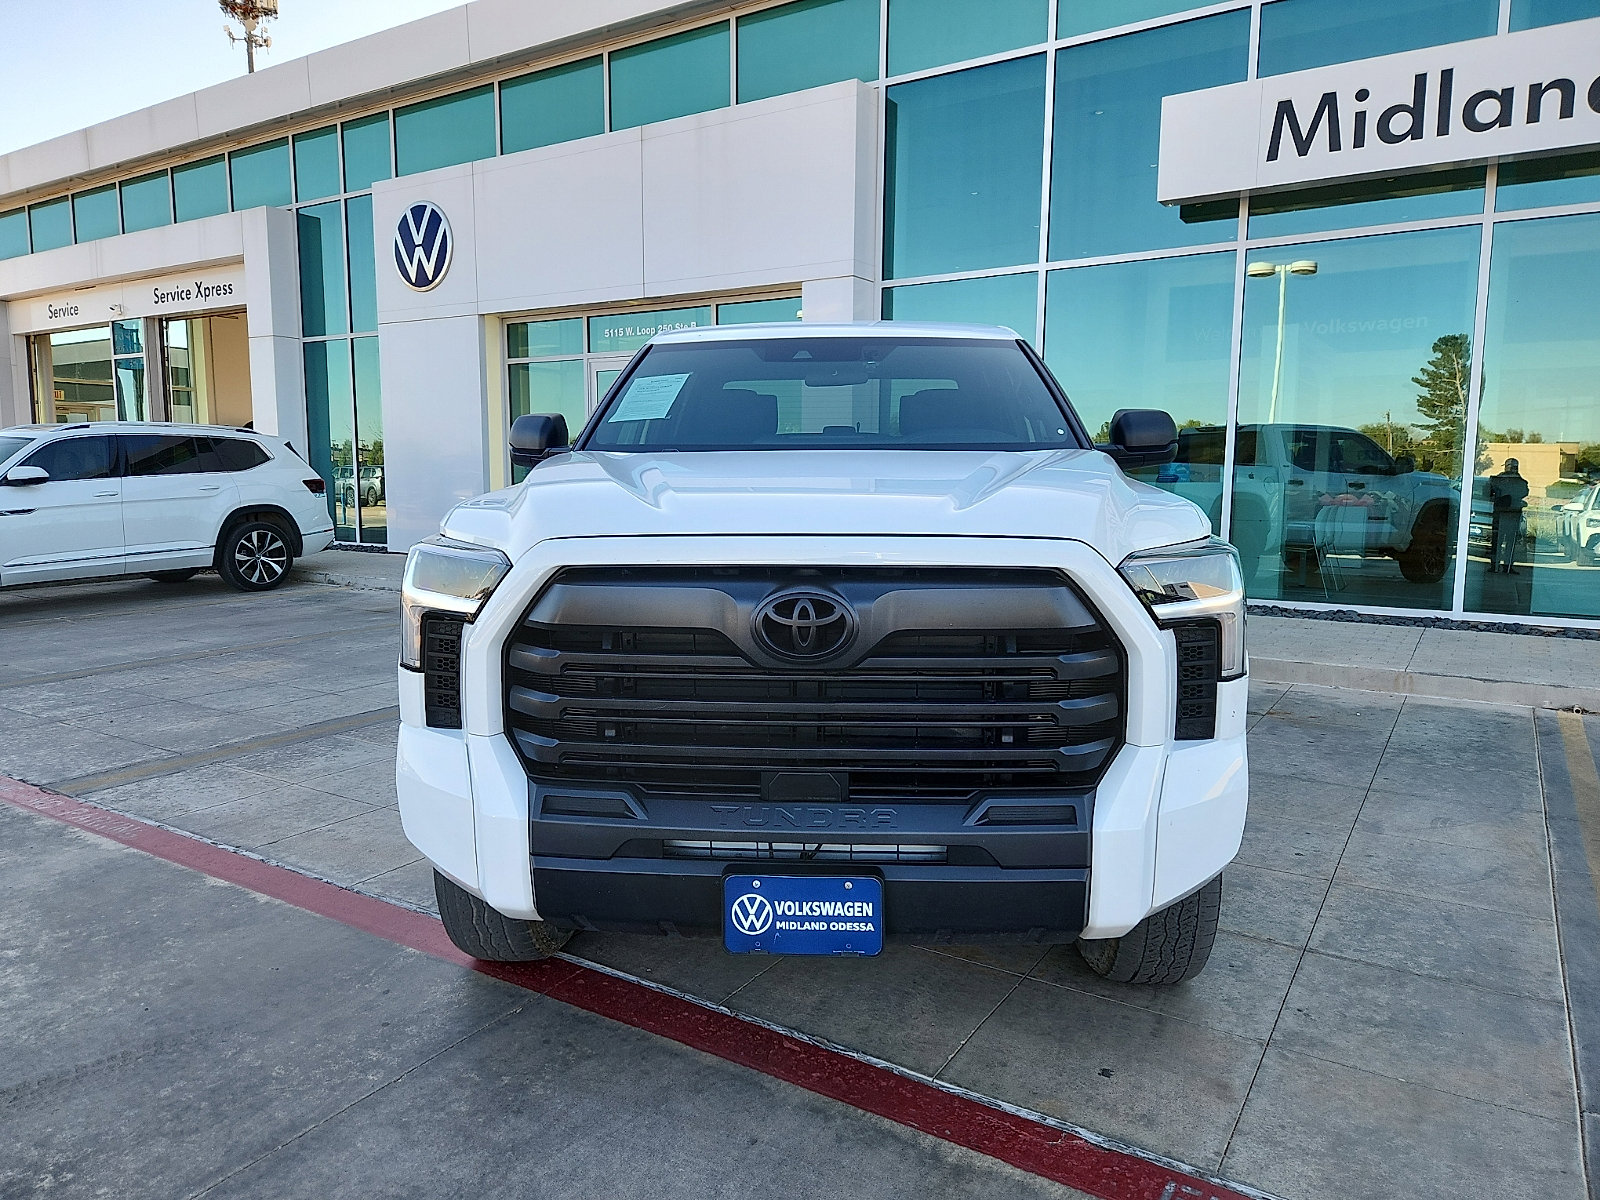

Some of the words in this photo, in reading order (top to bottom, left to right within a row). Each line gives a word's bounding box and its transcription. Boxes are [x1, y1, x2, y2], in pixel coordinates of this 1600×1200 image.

[1265, 67, 1600, 162] Midlan
[153, 285, 192, 305] Service
[195, 281, 233, 302] Xpress
[48, 303, 79, 320] Service
[604, 328, 624, 337] 5115
[625, 327, 635, 336] W.
[637, 326, 656, 337] Loop
[1304, 316, 1428, 334] Volkswagen
[711, 805, 898, 829] TUNDRA
[773, 900, 873, 917] VOLKSWAGEN
[775, 921, 828, 931] MIDLAND
[829, 921, 875, 932] ODESSA
